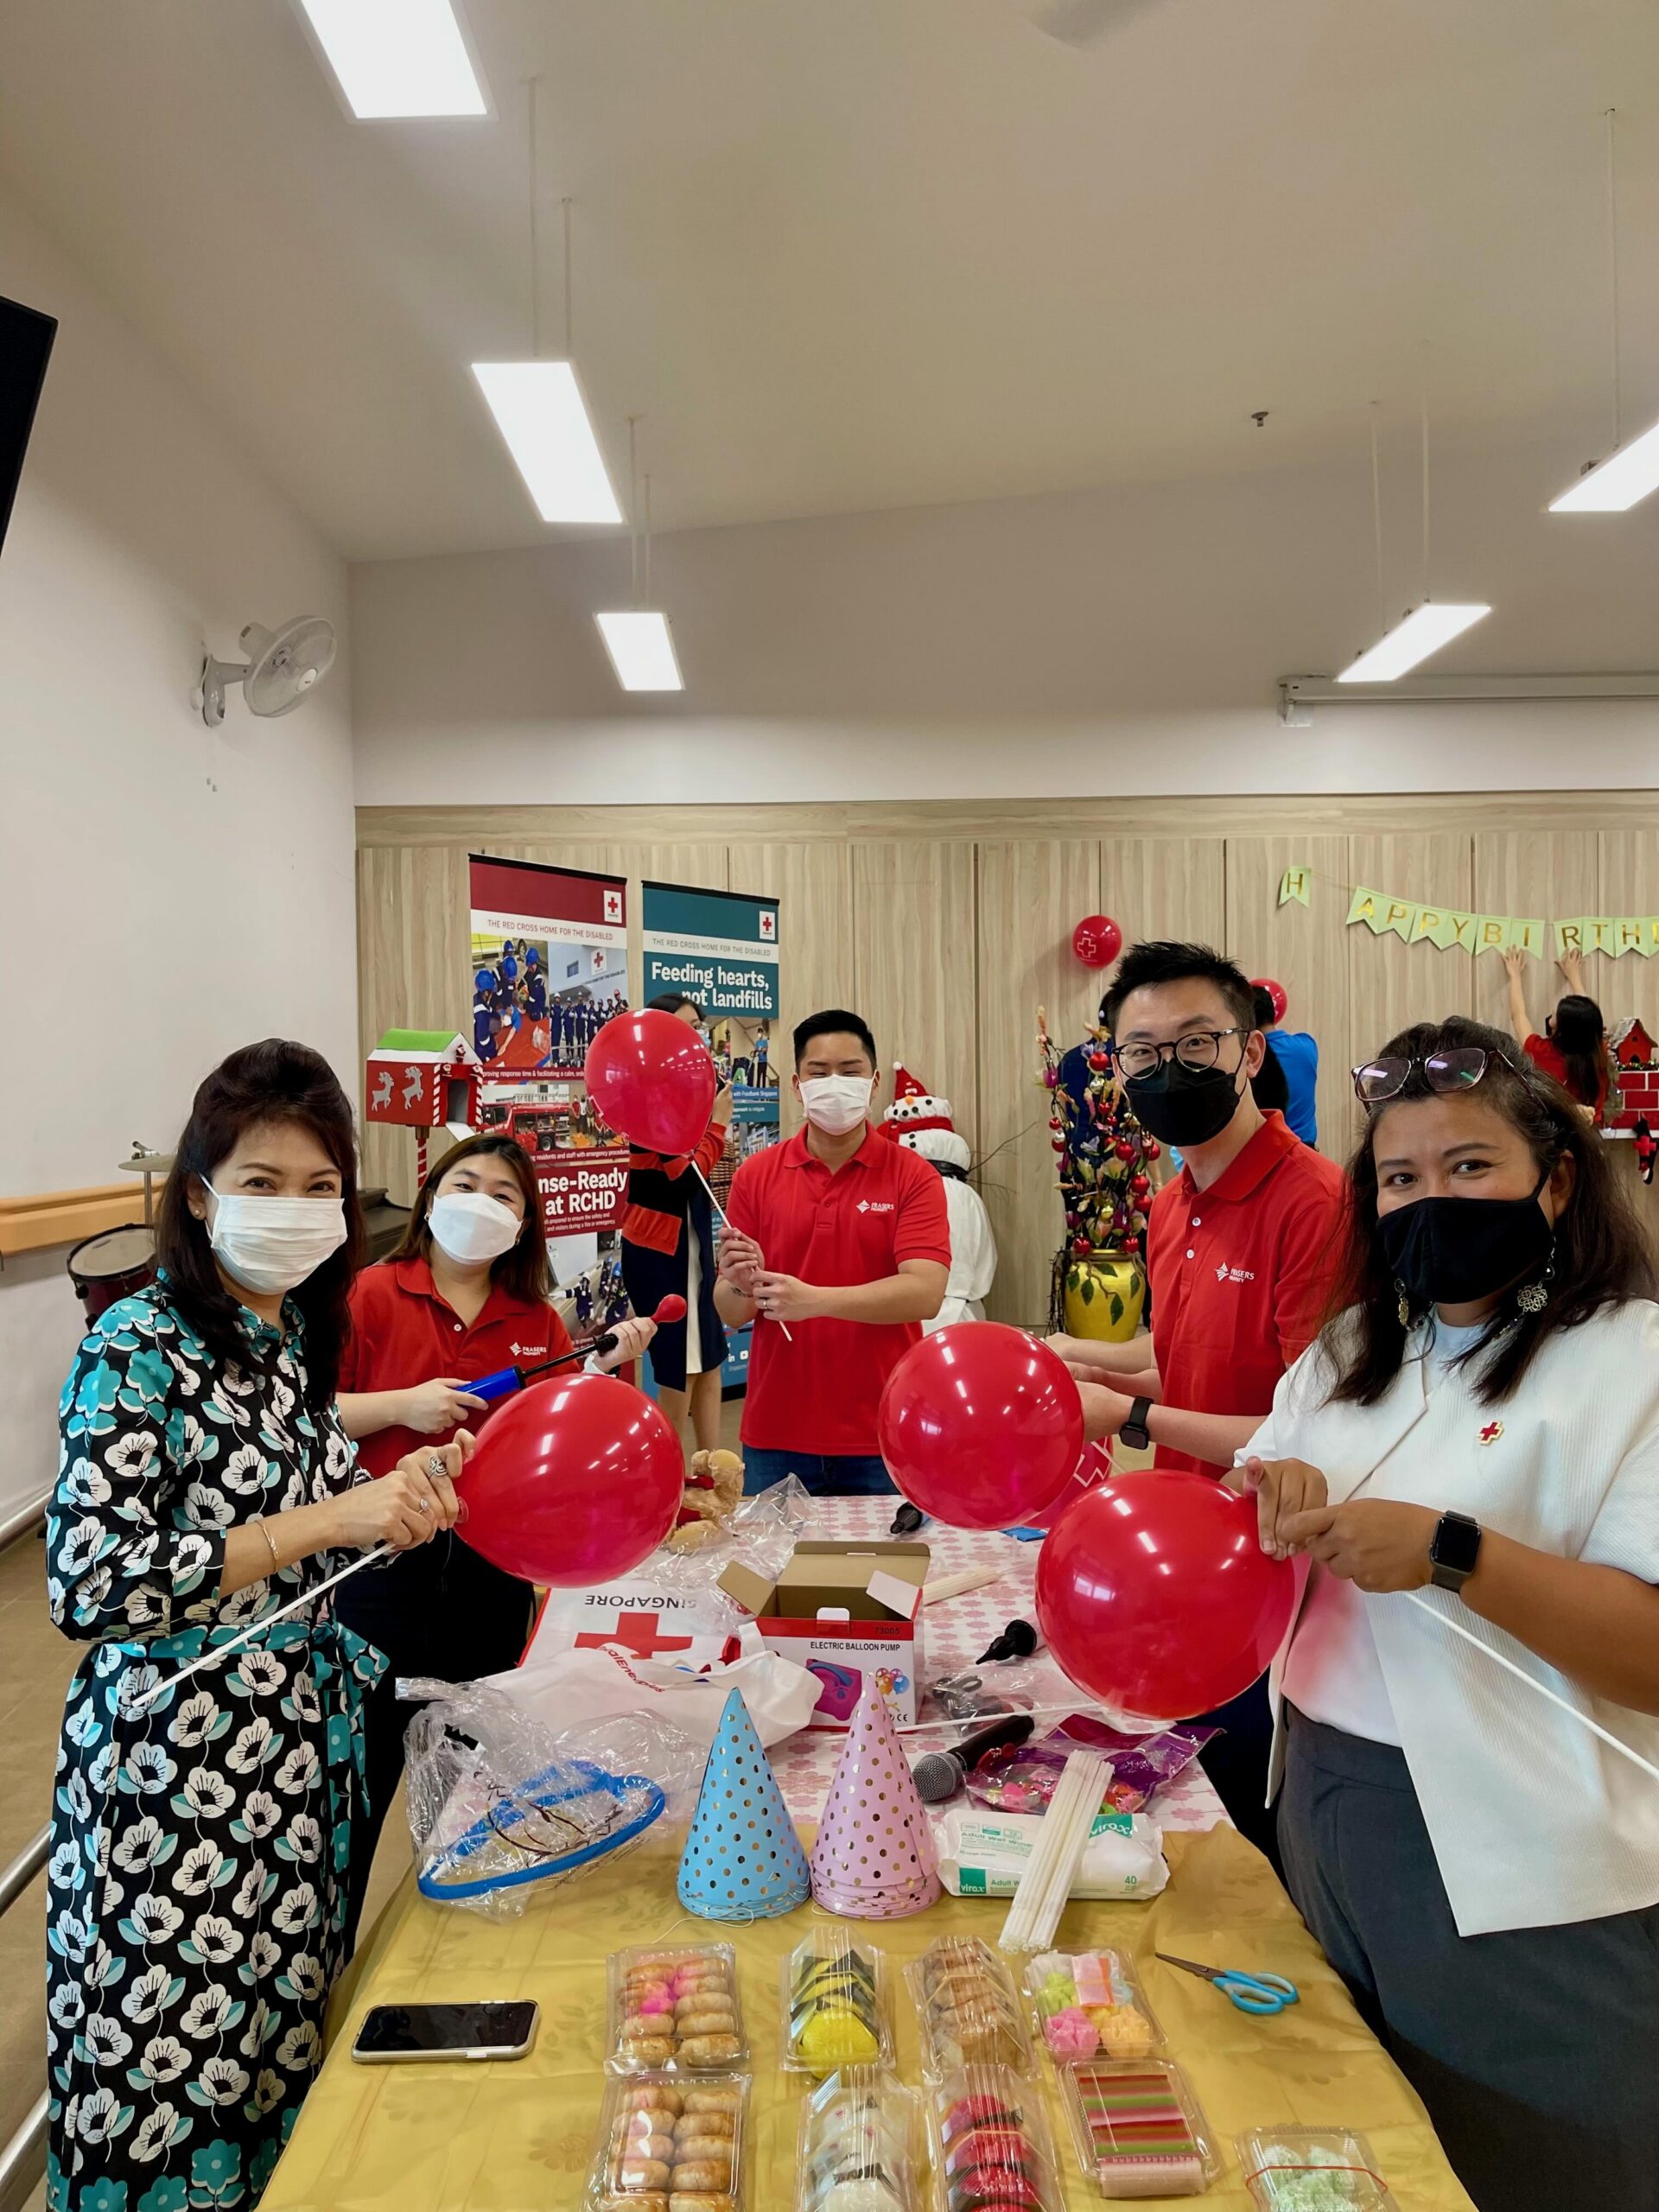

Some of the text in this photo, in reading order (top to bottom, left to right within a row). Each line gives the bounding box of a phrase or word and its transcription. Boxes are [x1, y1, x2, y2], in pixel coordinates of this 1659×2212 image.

[487, 919, 613, 940] THE RED CROSS HOME FOR THE DISABLED
[680, 940, 700, 949] CROSS
[701, 943, 719, 951] HOME
[732, 945, 743, 954] THE
[745, 947, 771, 957] DISABLED
[652, 961, 714, 988] Feeding
[717, 965, 769, 991] hearts,
[712, 988, 772, 1010] landfills
[545, 1191, 616, 1217] at RCHD
[1230, 1268, 1255, 1281] FRASERS
[584, 1595, 697, 1609] SINGAPORE
[875, 1626, 900, 1635] 73005
[810, 1642, 845, 1650] ELECTRIC
[845, 1643, 880, 1651] BALLOON
[1124, 1875, 1137, 1885] 40
